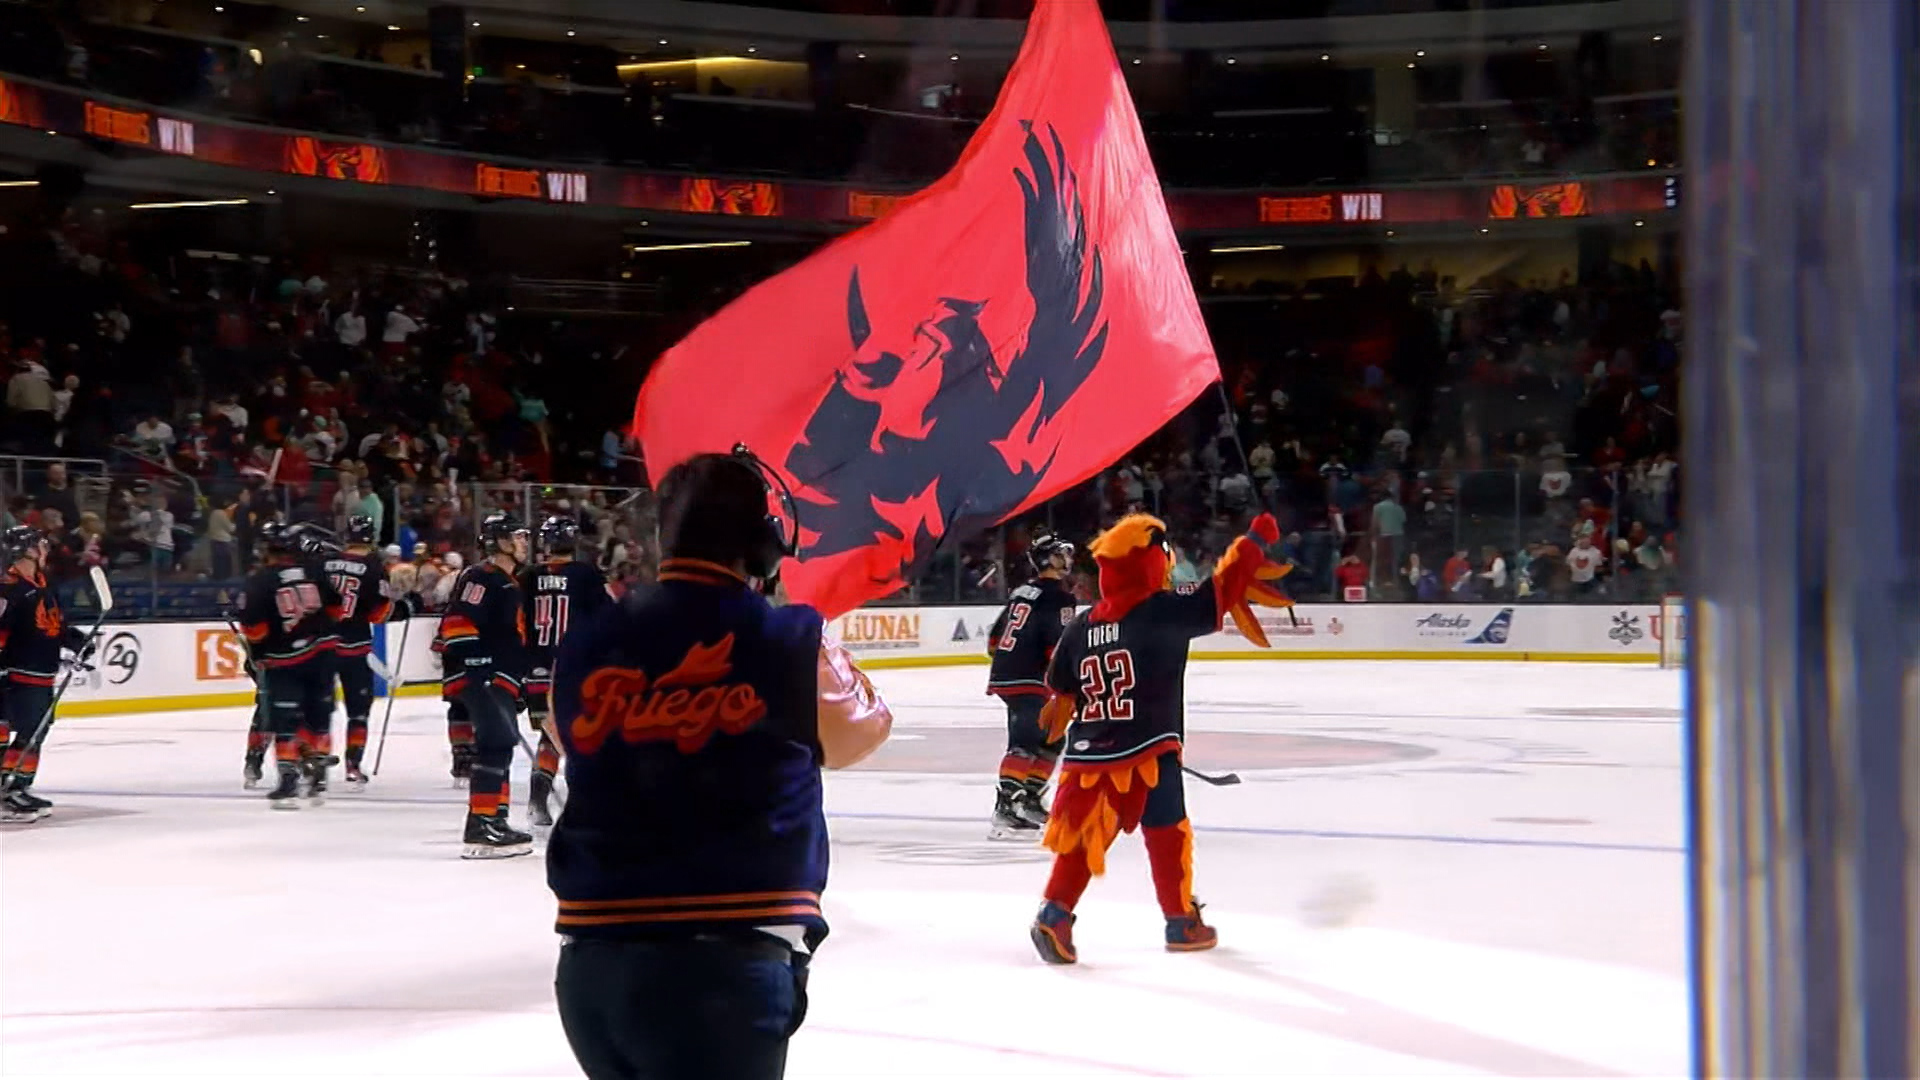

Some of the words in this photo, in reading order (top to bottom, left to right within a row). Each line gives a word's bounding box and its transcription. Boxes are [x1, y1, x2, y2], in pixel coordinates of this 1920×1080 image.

[157, 118, 194, 155] WIN
[546, 171, 587, 203] WIN
[1341, 193, 1382, 221] WIN
[537, 575, 568, 590] EVANS
[534, 595, 570, 646] 41
[1087, 621, 1120, 648] FUEGO
[107, 643, 139, 685] 29
[1080, 649, 1136, 722] 22
[571, 666, 768, 755] Fuego
